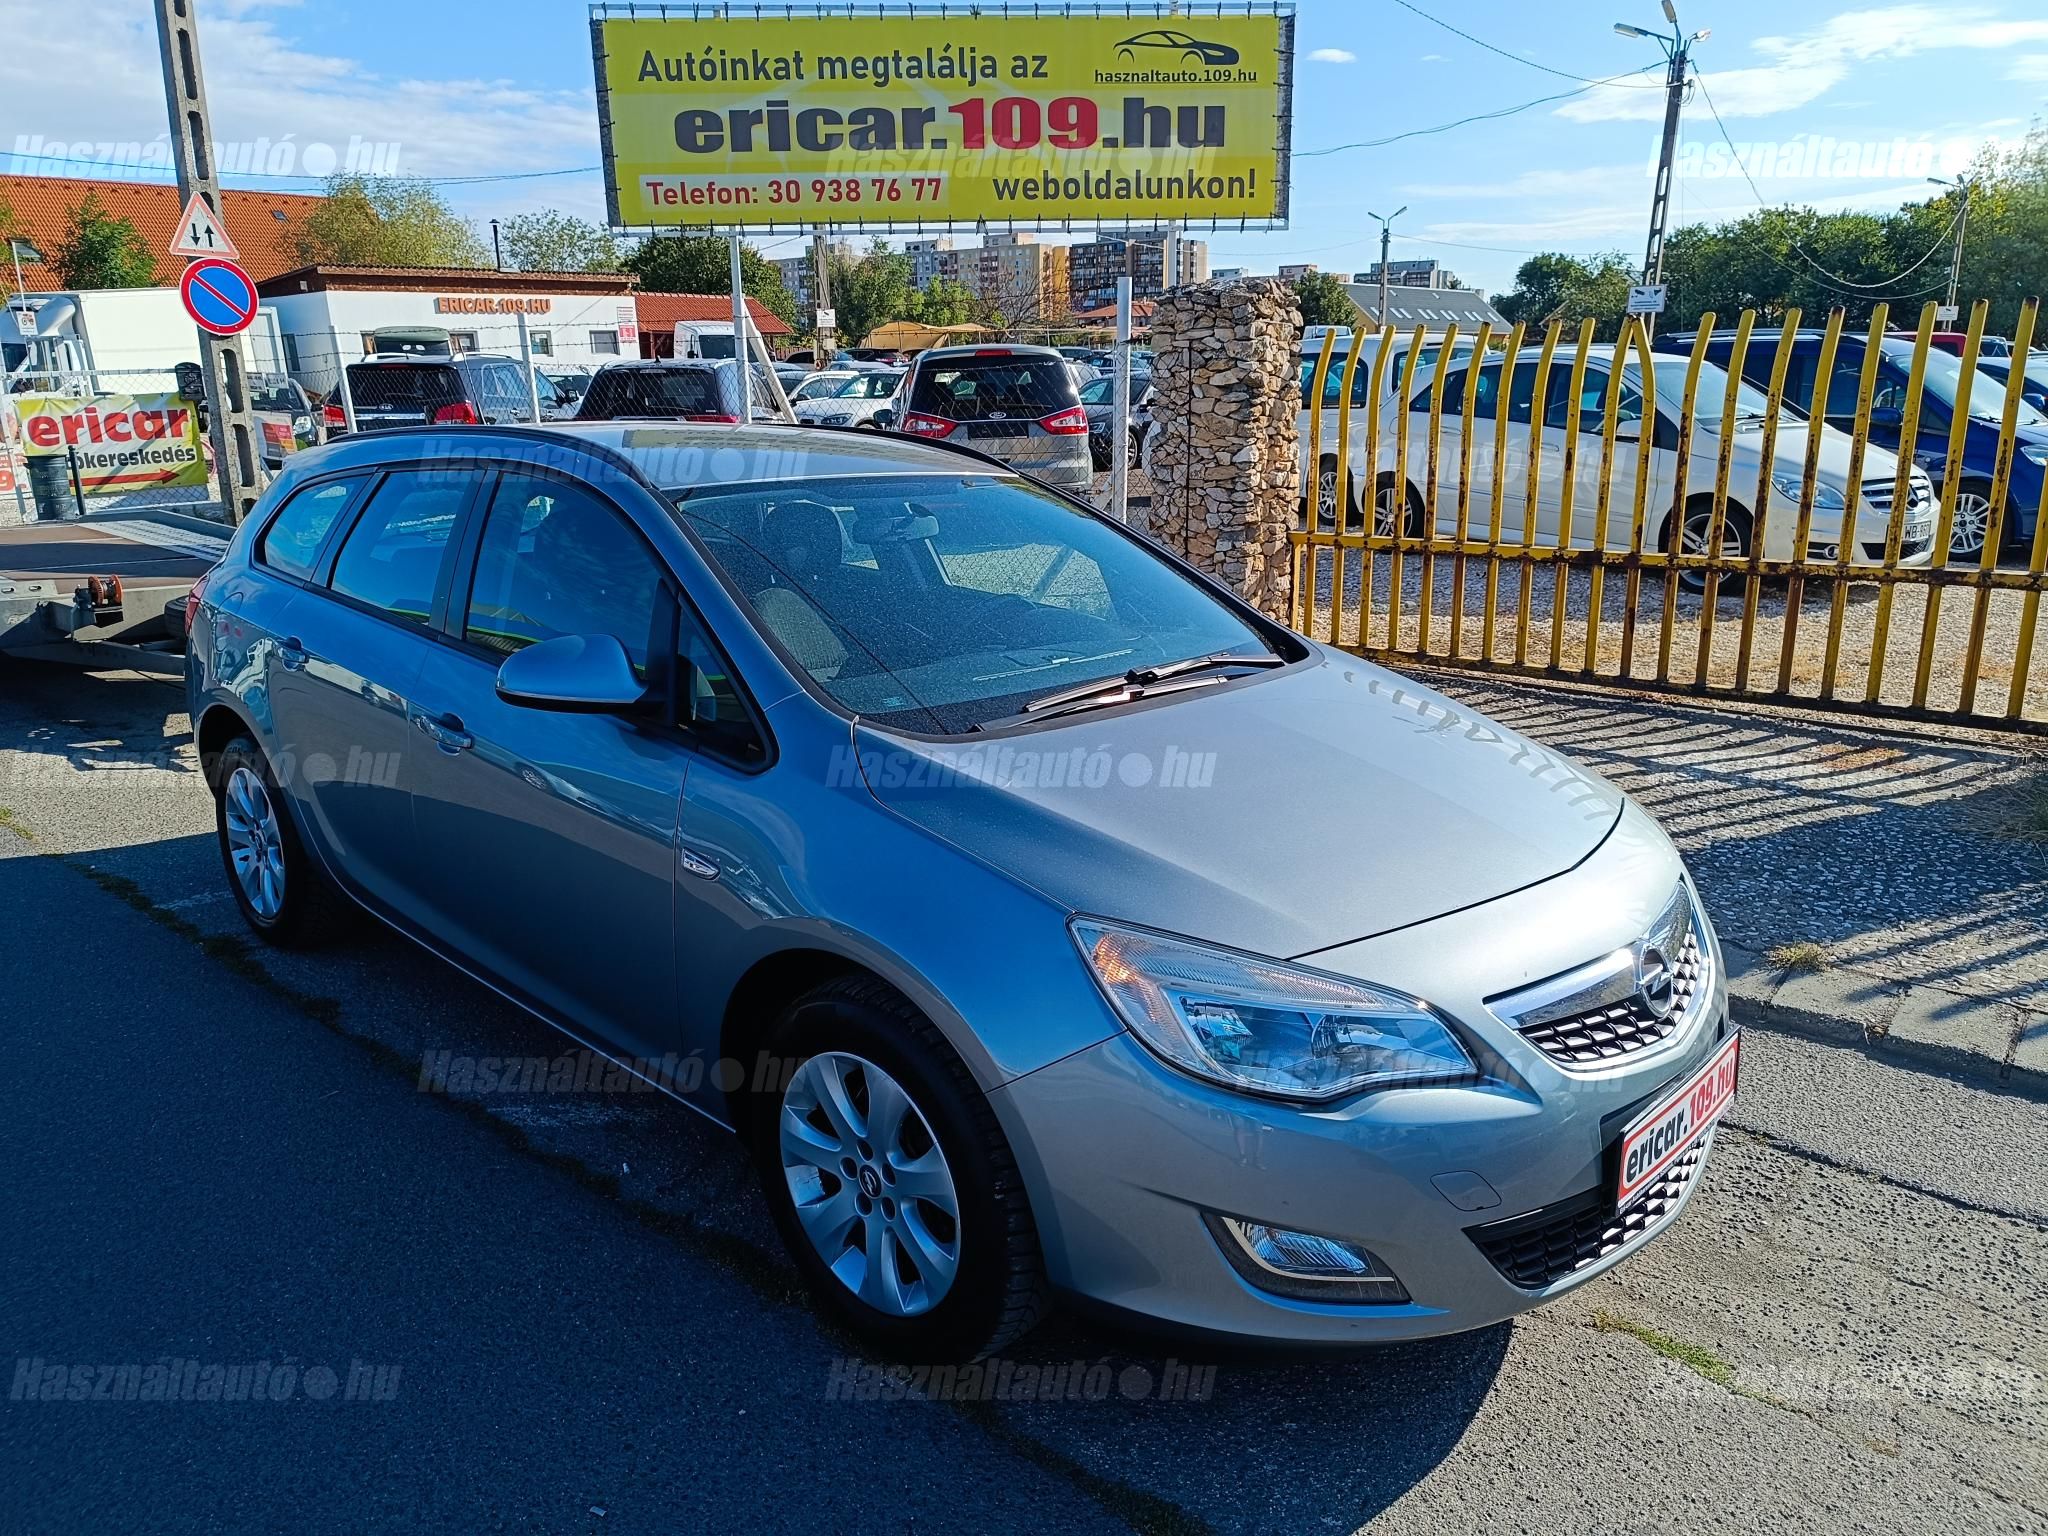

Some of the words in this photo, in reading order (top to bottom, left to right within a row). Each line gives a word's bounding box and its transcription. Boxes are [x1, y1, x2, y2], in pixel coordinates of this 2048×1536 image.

[638, 45, 804, 82] Autóinkat
[817, 43, 997, 88] megtalálja
[1010, 55, 1048, 79] az
[1094, 69, 1258, 83] hasznaltauto.109.hu
[674, 96, 1226, 154] ericar.109.hu
[646, 181, 758, 205] Telefon:
[768, 179, 801, 204] 30
[811, 178, 861, 203] 938
[871, 178, 901, 202] 76
[911, 177, 942, 202] 77
[992, 168, 1256, 200] weboldalunkon!
[435, 297, 551, 314] ERICAR.109.HU
[27, 406, 190, 447] ericar
[1625, 1056, 1735, 1184] ericar.109.hu
